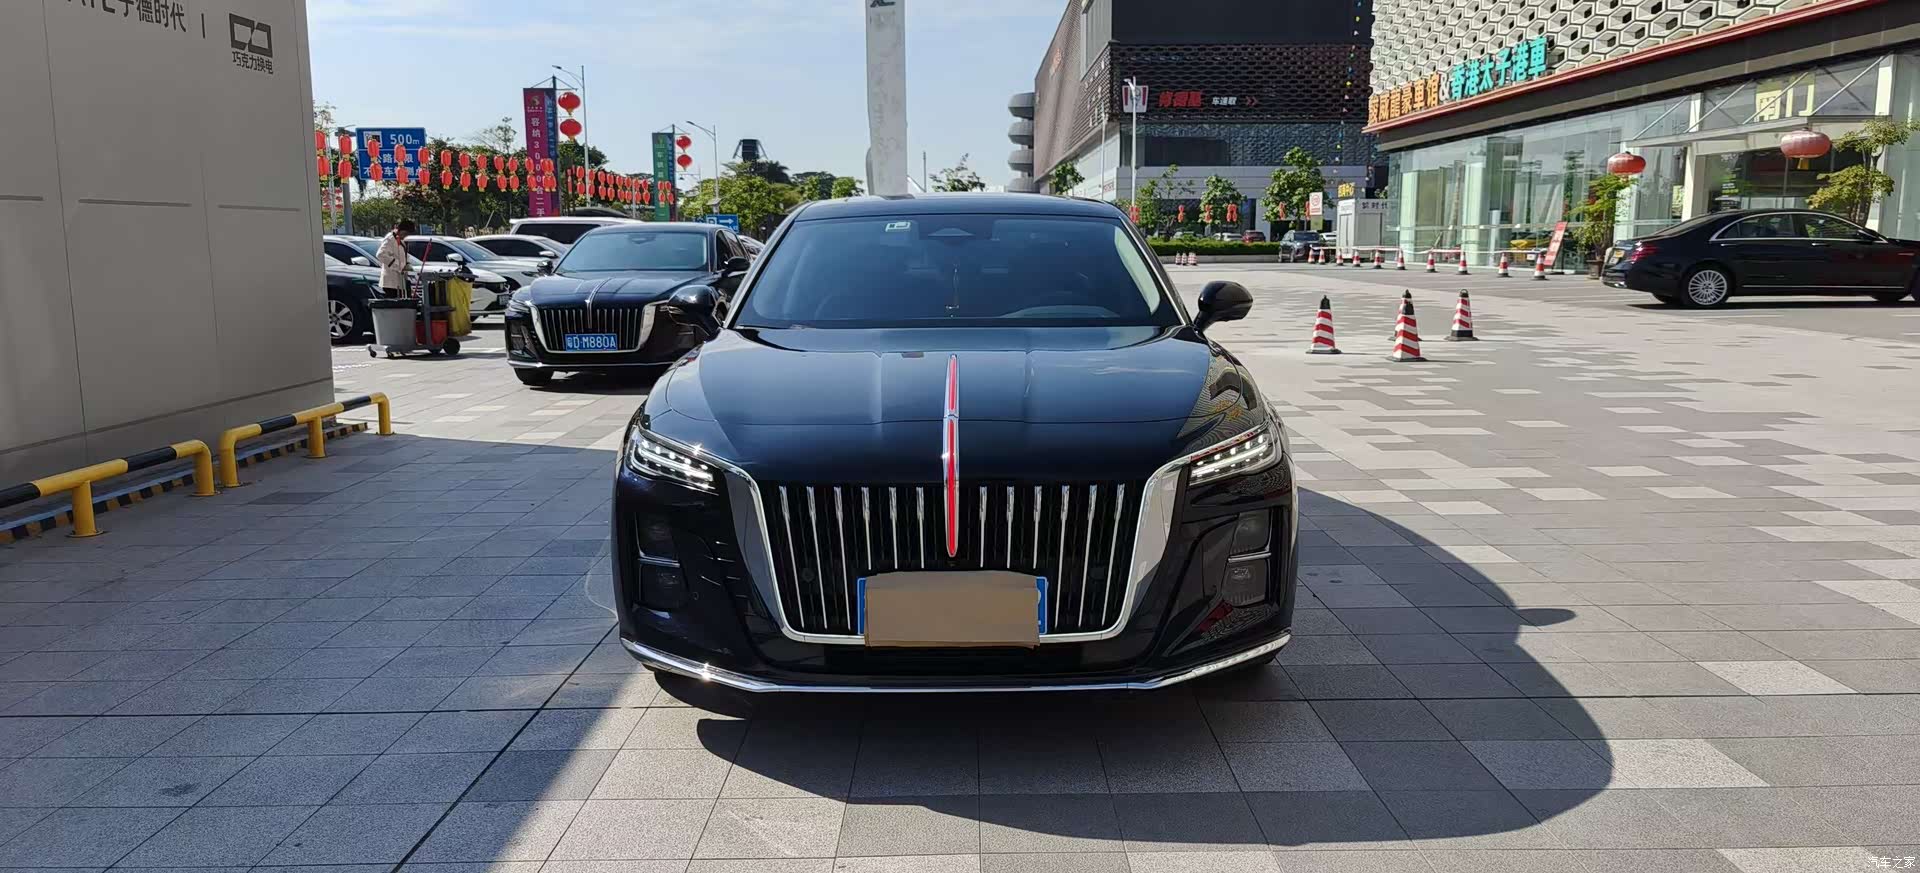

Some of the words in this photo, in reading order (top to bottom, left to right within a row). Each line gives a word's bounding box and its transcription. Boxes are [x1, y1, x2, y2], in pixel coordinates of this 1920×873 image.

[231, 50, 274, 75] 巧克力换电
[389, 133, 420, 146] 500m
